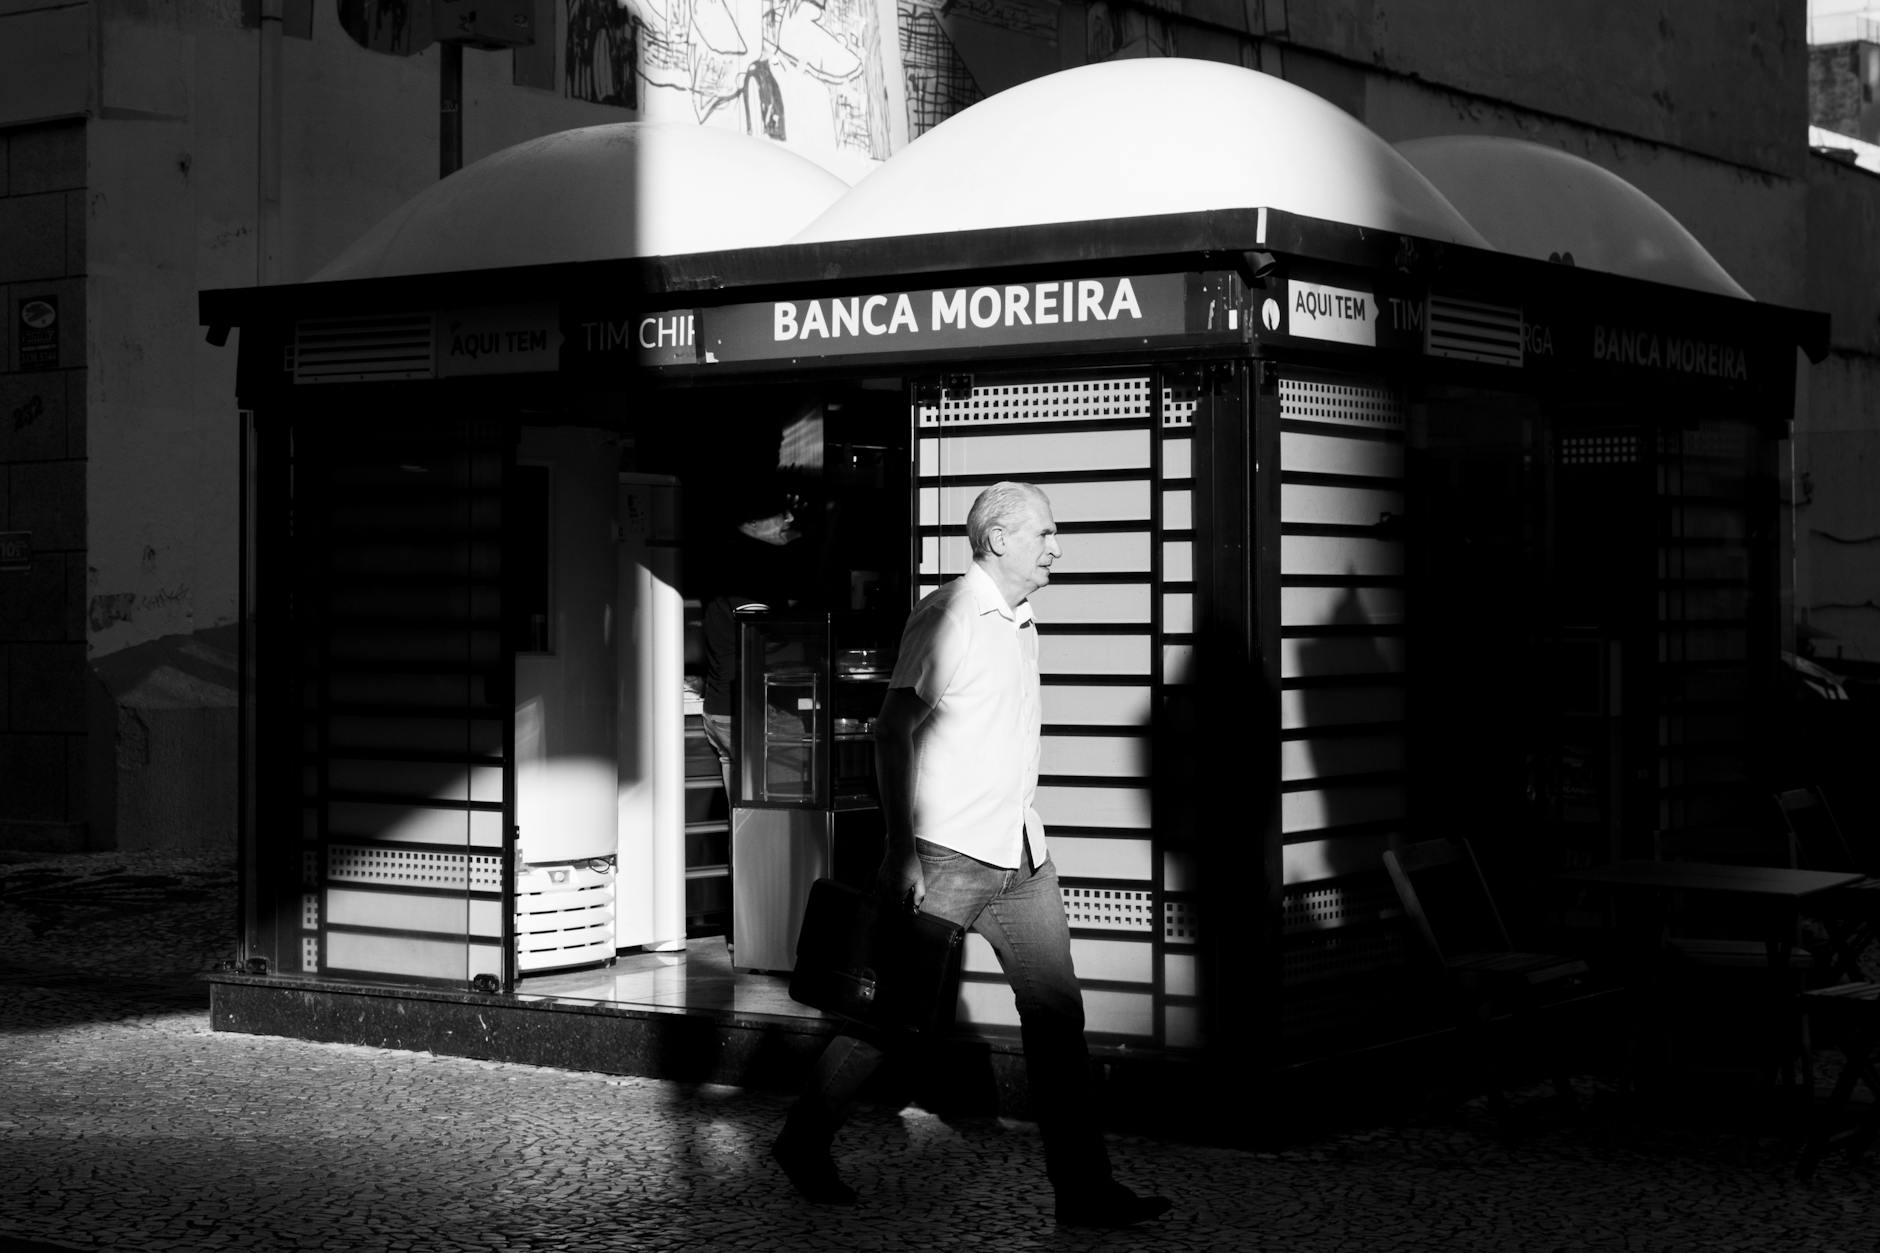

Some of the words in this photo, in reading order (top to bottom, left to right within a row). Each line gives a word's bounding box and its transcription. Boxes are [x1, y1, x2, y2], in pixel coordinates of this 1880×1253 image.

[774, 294, 919, 341] BANCA
[932, 278, 1142, 331] MOREIRA
[1296, 290, 1332, 320] AQUI
[1335, 295, 1366, 322] TEM
[1389, 298, 1424, 332] TIM
[451, 333, 500, 358] AQUI
[505, 329, 548, 353] TEM
[582, 320, 629, 352] TIM
[1593, 324, 1661, 367] BANCA
[1666, 338, 1748, 381] MOREIRA
